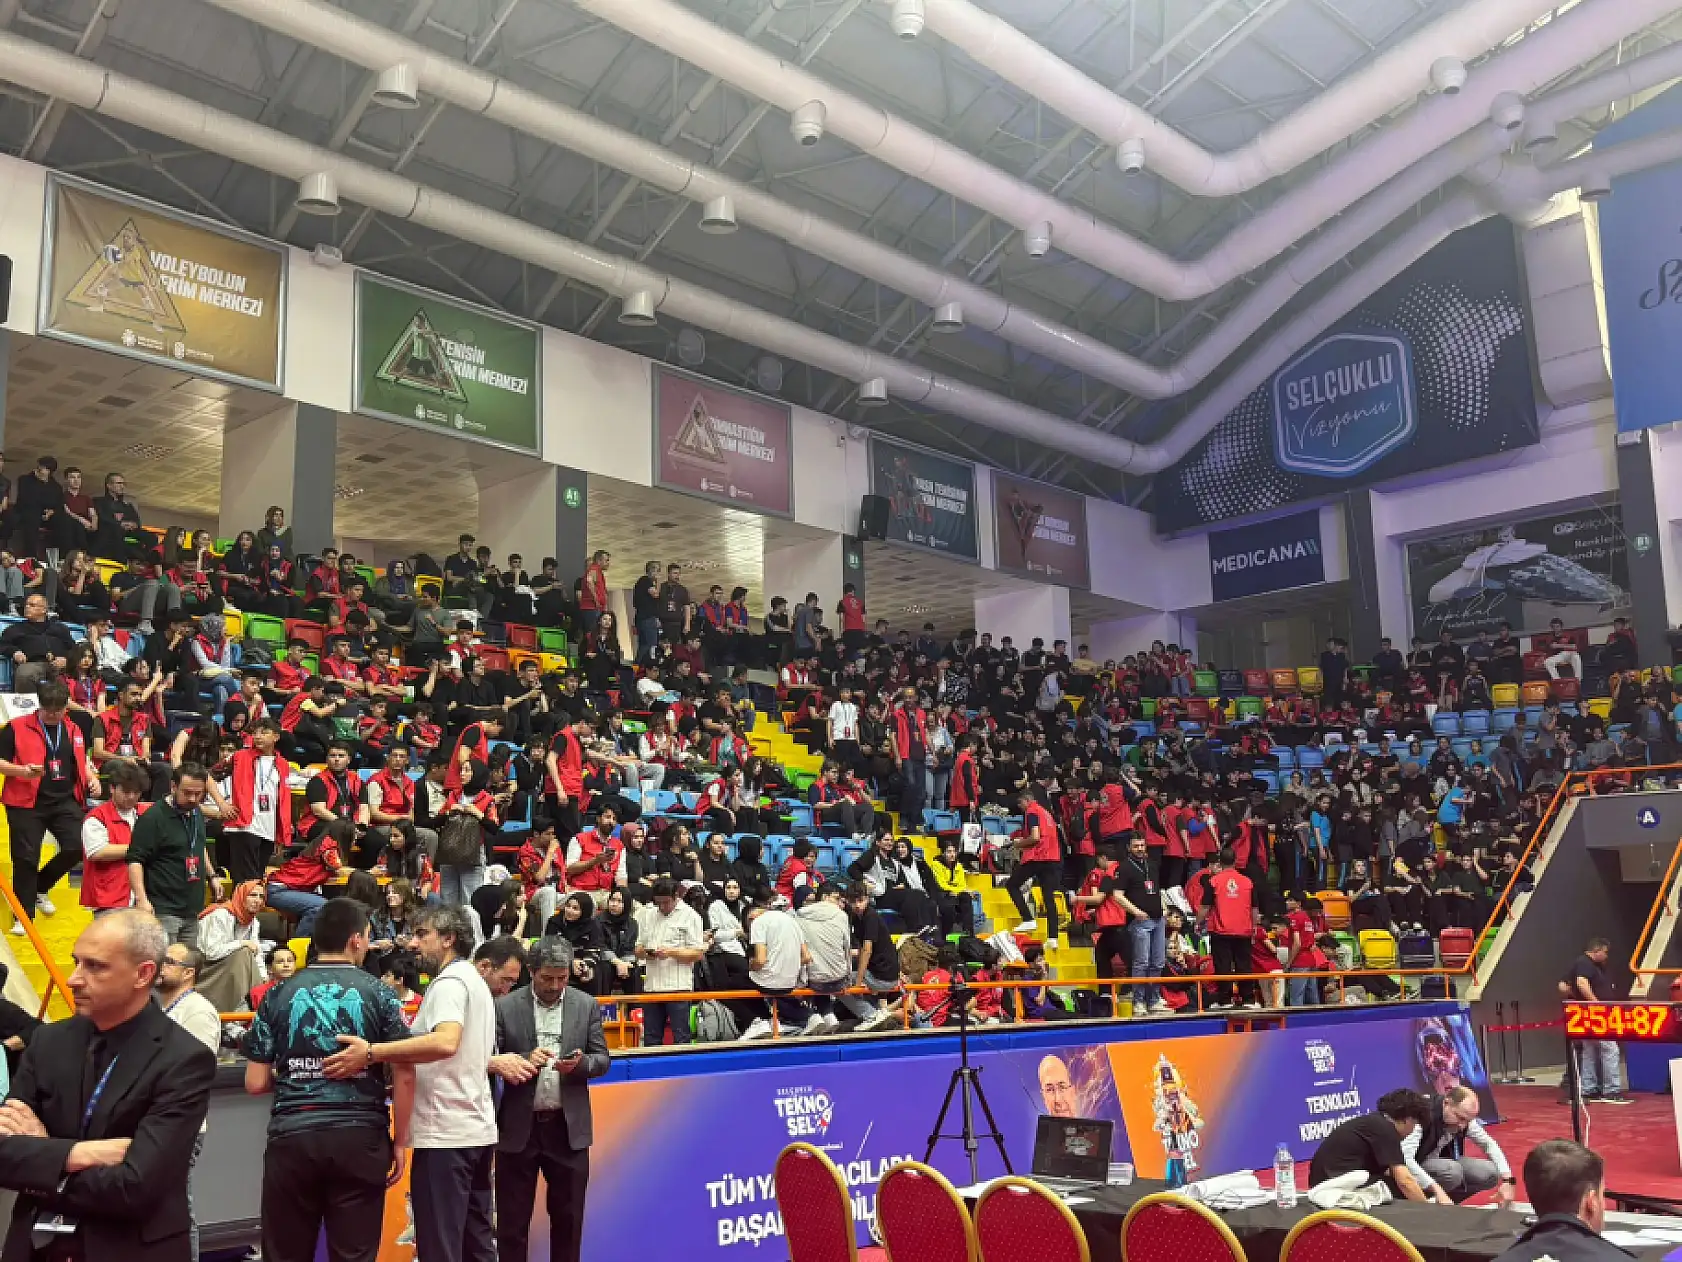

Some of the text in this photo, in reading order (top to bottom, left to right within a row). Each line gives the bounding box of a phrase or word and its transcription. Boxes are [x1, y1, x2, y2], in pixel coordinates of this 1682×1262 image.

[199, 285, 264, 317] MERKEZİ
[1286, 353, 1393, 411] SELÇUKLU
[1291, 403, 1392, 450] Vizyonu
[1212, 540, 1308, 575] MEDICANA
[1643, 809, 1656, 824] A
[1564, 1004, 1669, 1036] 2:54:87
[774, 1094, 830, 1118] TEKNO
[787, 1115, 816, 1136] SEL
[706, 1174, 755, 1208] TÜM
